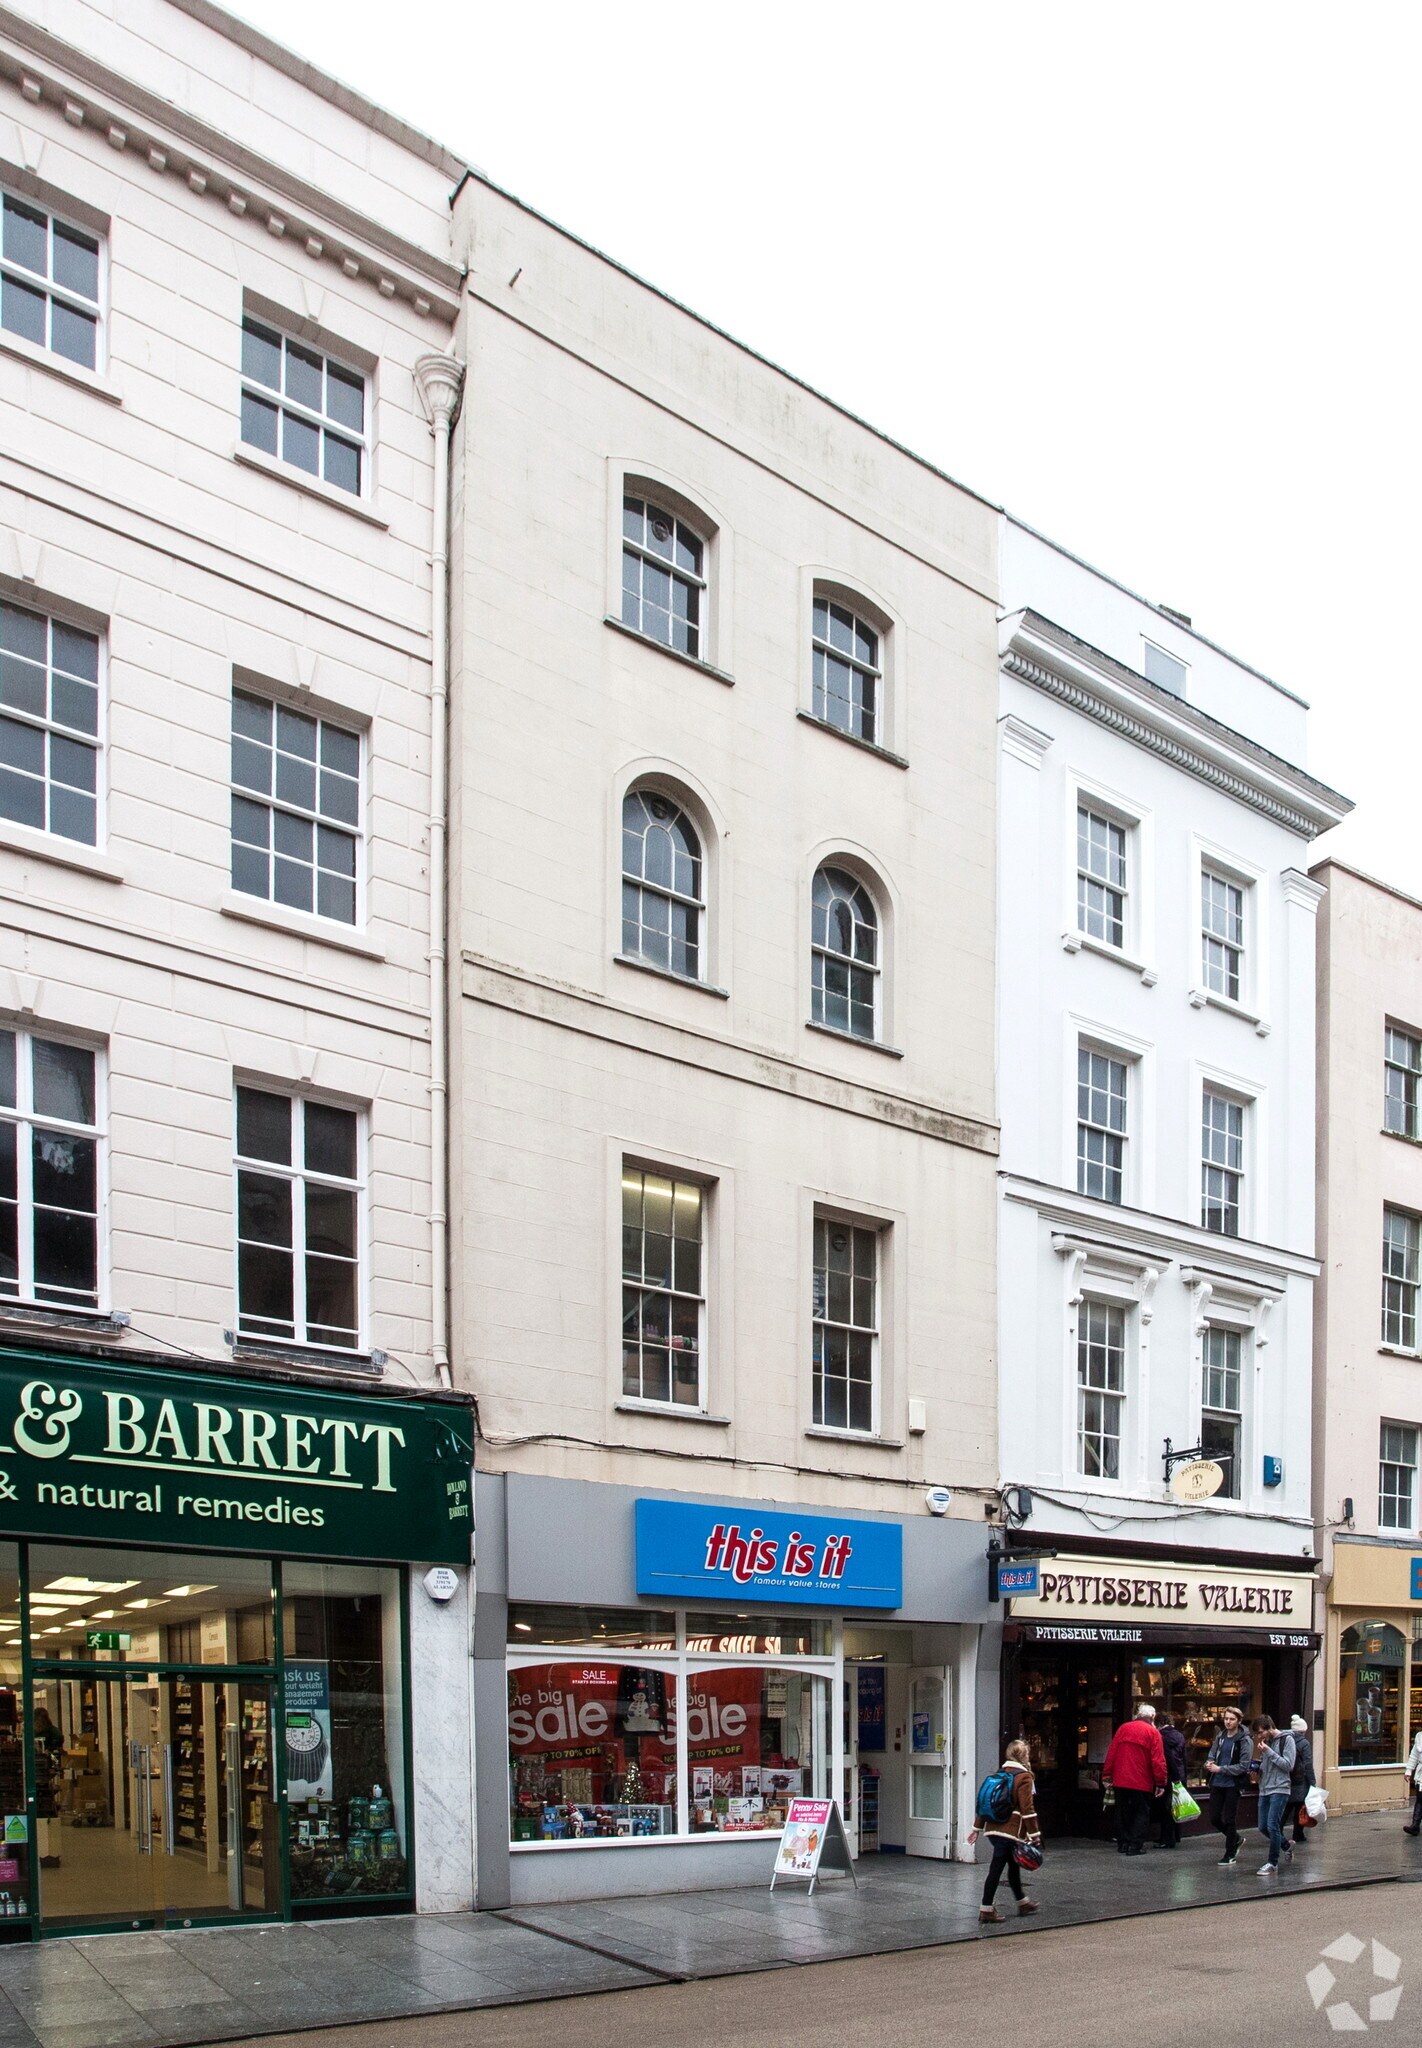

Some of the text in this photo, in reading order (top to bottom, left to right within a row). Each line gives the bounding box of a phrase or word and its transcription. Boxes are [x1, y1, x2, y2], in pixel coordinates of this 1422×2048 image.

[14, 1381, 406, 1492] & BARRETT
[1180, 1462, 1216, 1477] PATISSERIE
[0, 1470, 325, 1527] & natural remedies
[1184, 1490, 1210, 1500] VALERIE
[448, 1504, 469, 1520] BARRETT
[704, 1524, 853, 1584] this is it
[753, 1576, 841, 1590] famous value stores
[1001, 1570, 1034, 1588] this is it
[1039, 1573, 1294, 1615] PATISSERIE VALERIE
[1035, 1626, 1143, 1642] PATISSERIE VALERIE
[1268, 1634, 1309, 1647] EST 1926
[306, 1671, 321, 1682] us
[582, 1670, 606, 1680] SALE
[1359, 1669, 1382, 1683] TASTY
[299, 1682, 323, 1690] weight
[513, 1689, 562, 1706] he big
[508, 1694, 609, 1745] sale
[551, 1751, 562, 1760] TO
[564, 1748, 583, 1757] 70%
[707, 1748, 724, 1756] 70%
[725, 1745, 741, 1754] OFF
[793, 1803, 827, 1812] Penny Sale
